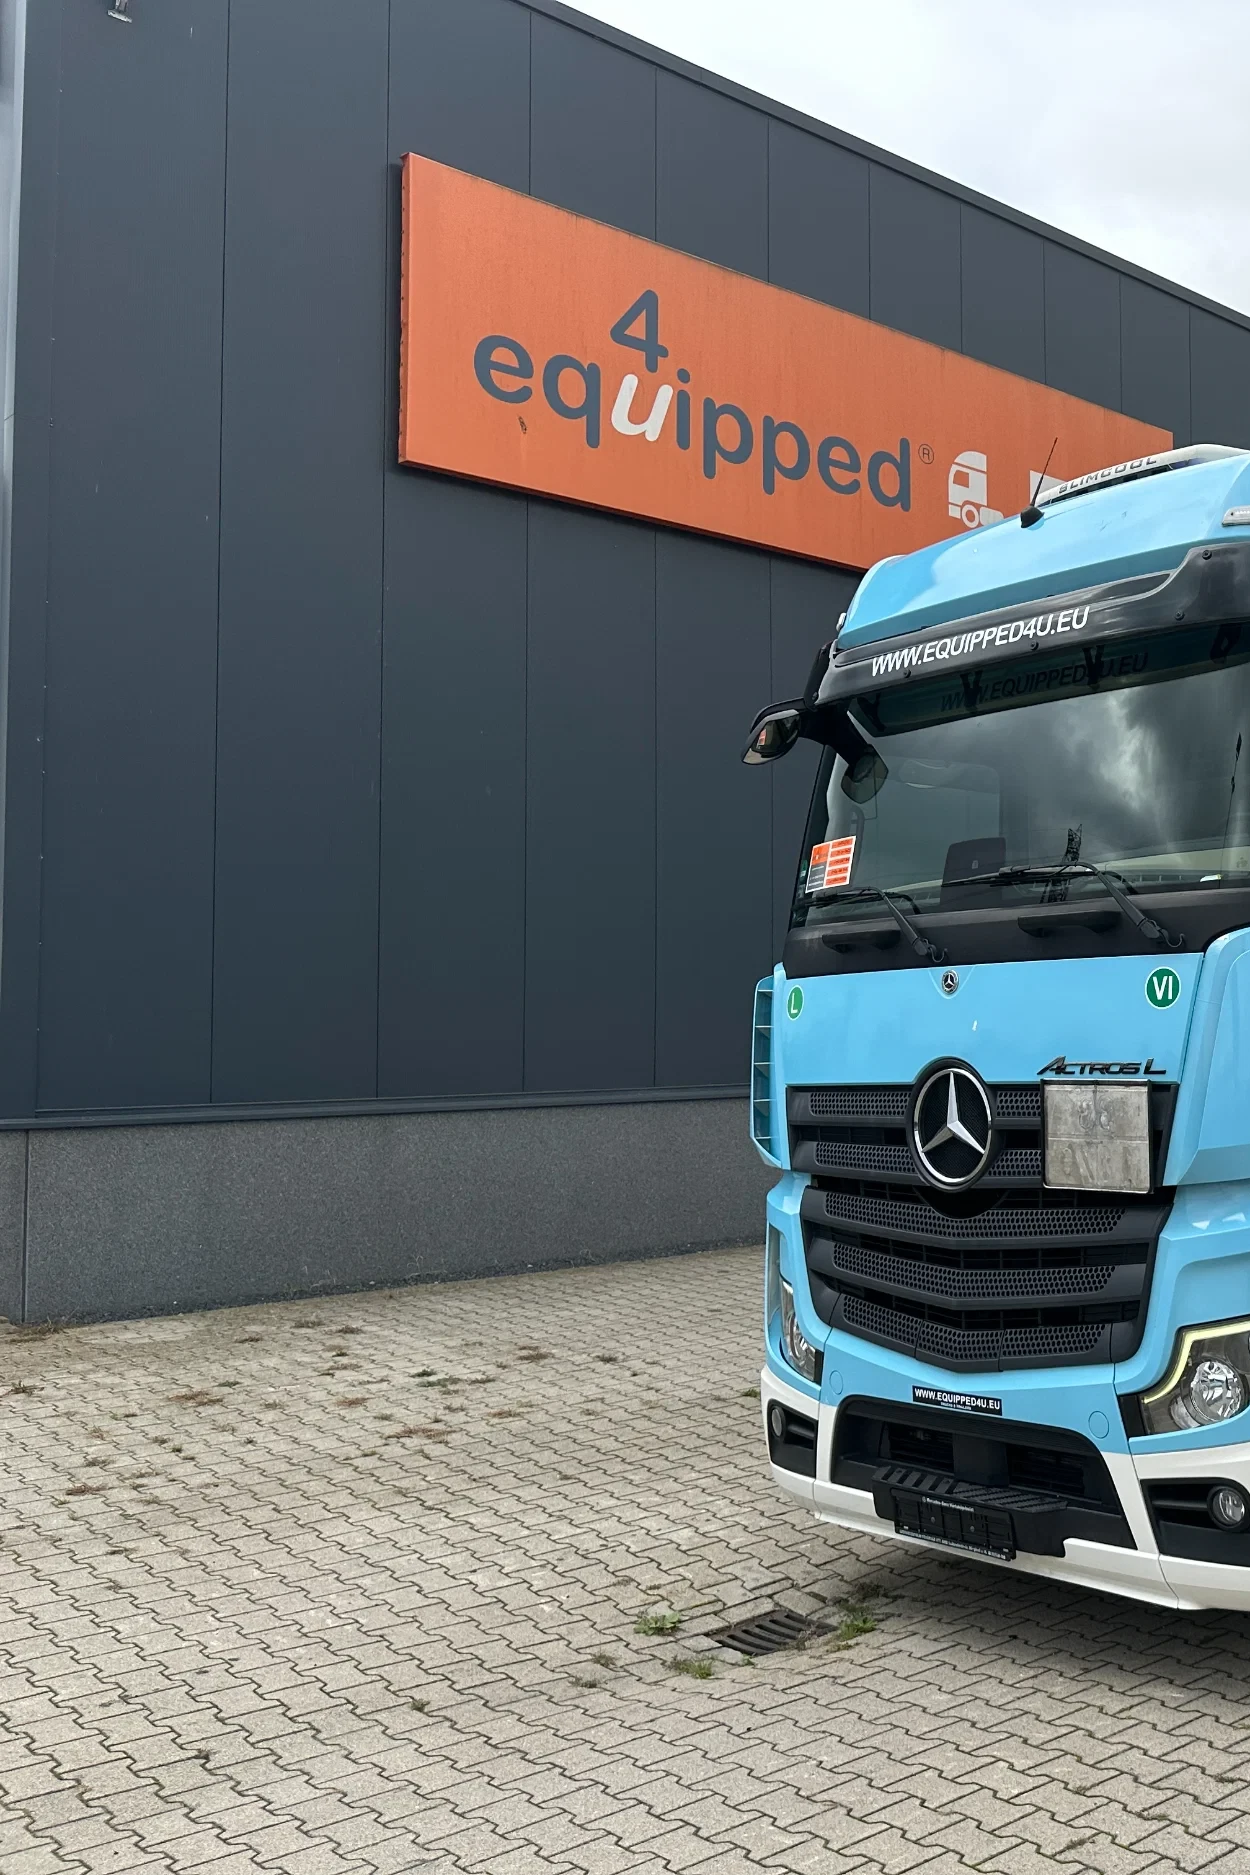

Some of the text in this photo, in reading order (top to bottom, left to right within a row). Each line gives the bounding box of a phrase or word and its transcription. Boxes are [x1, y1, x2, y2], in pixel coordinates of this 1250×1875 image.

[609, 288, 669, 373] 4
[473, 333, 913, 513] equipped
[871, 606, 1090, 677] WWW.EQUIPPED4U.EU
[790, 992, 799, 1014] L
[1152, 975, 1173, 1001] VI
[914, 1387, 1000, 1410] WWW.EQUIPPED4U.EU
